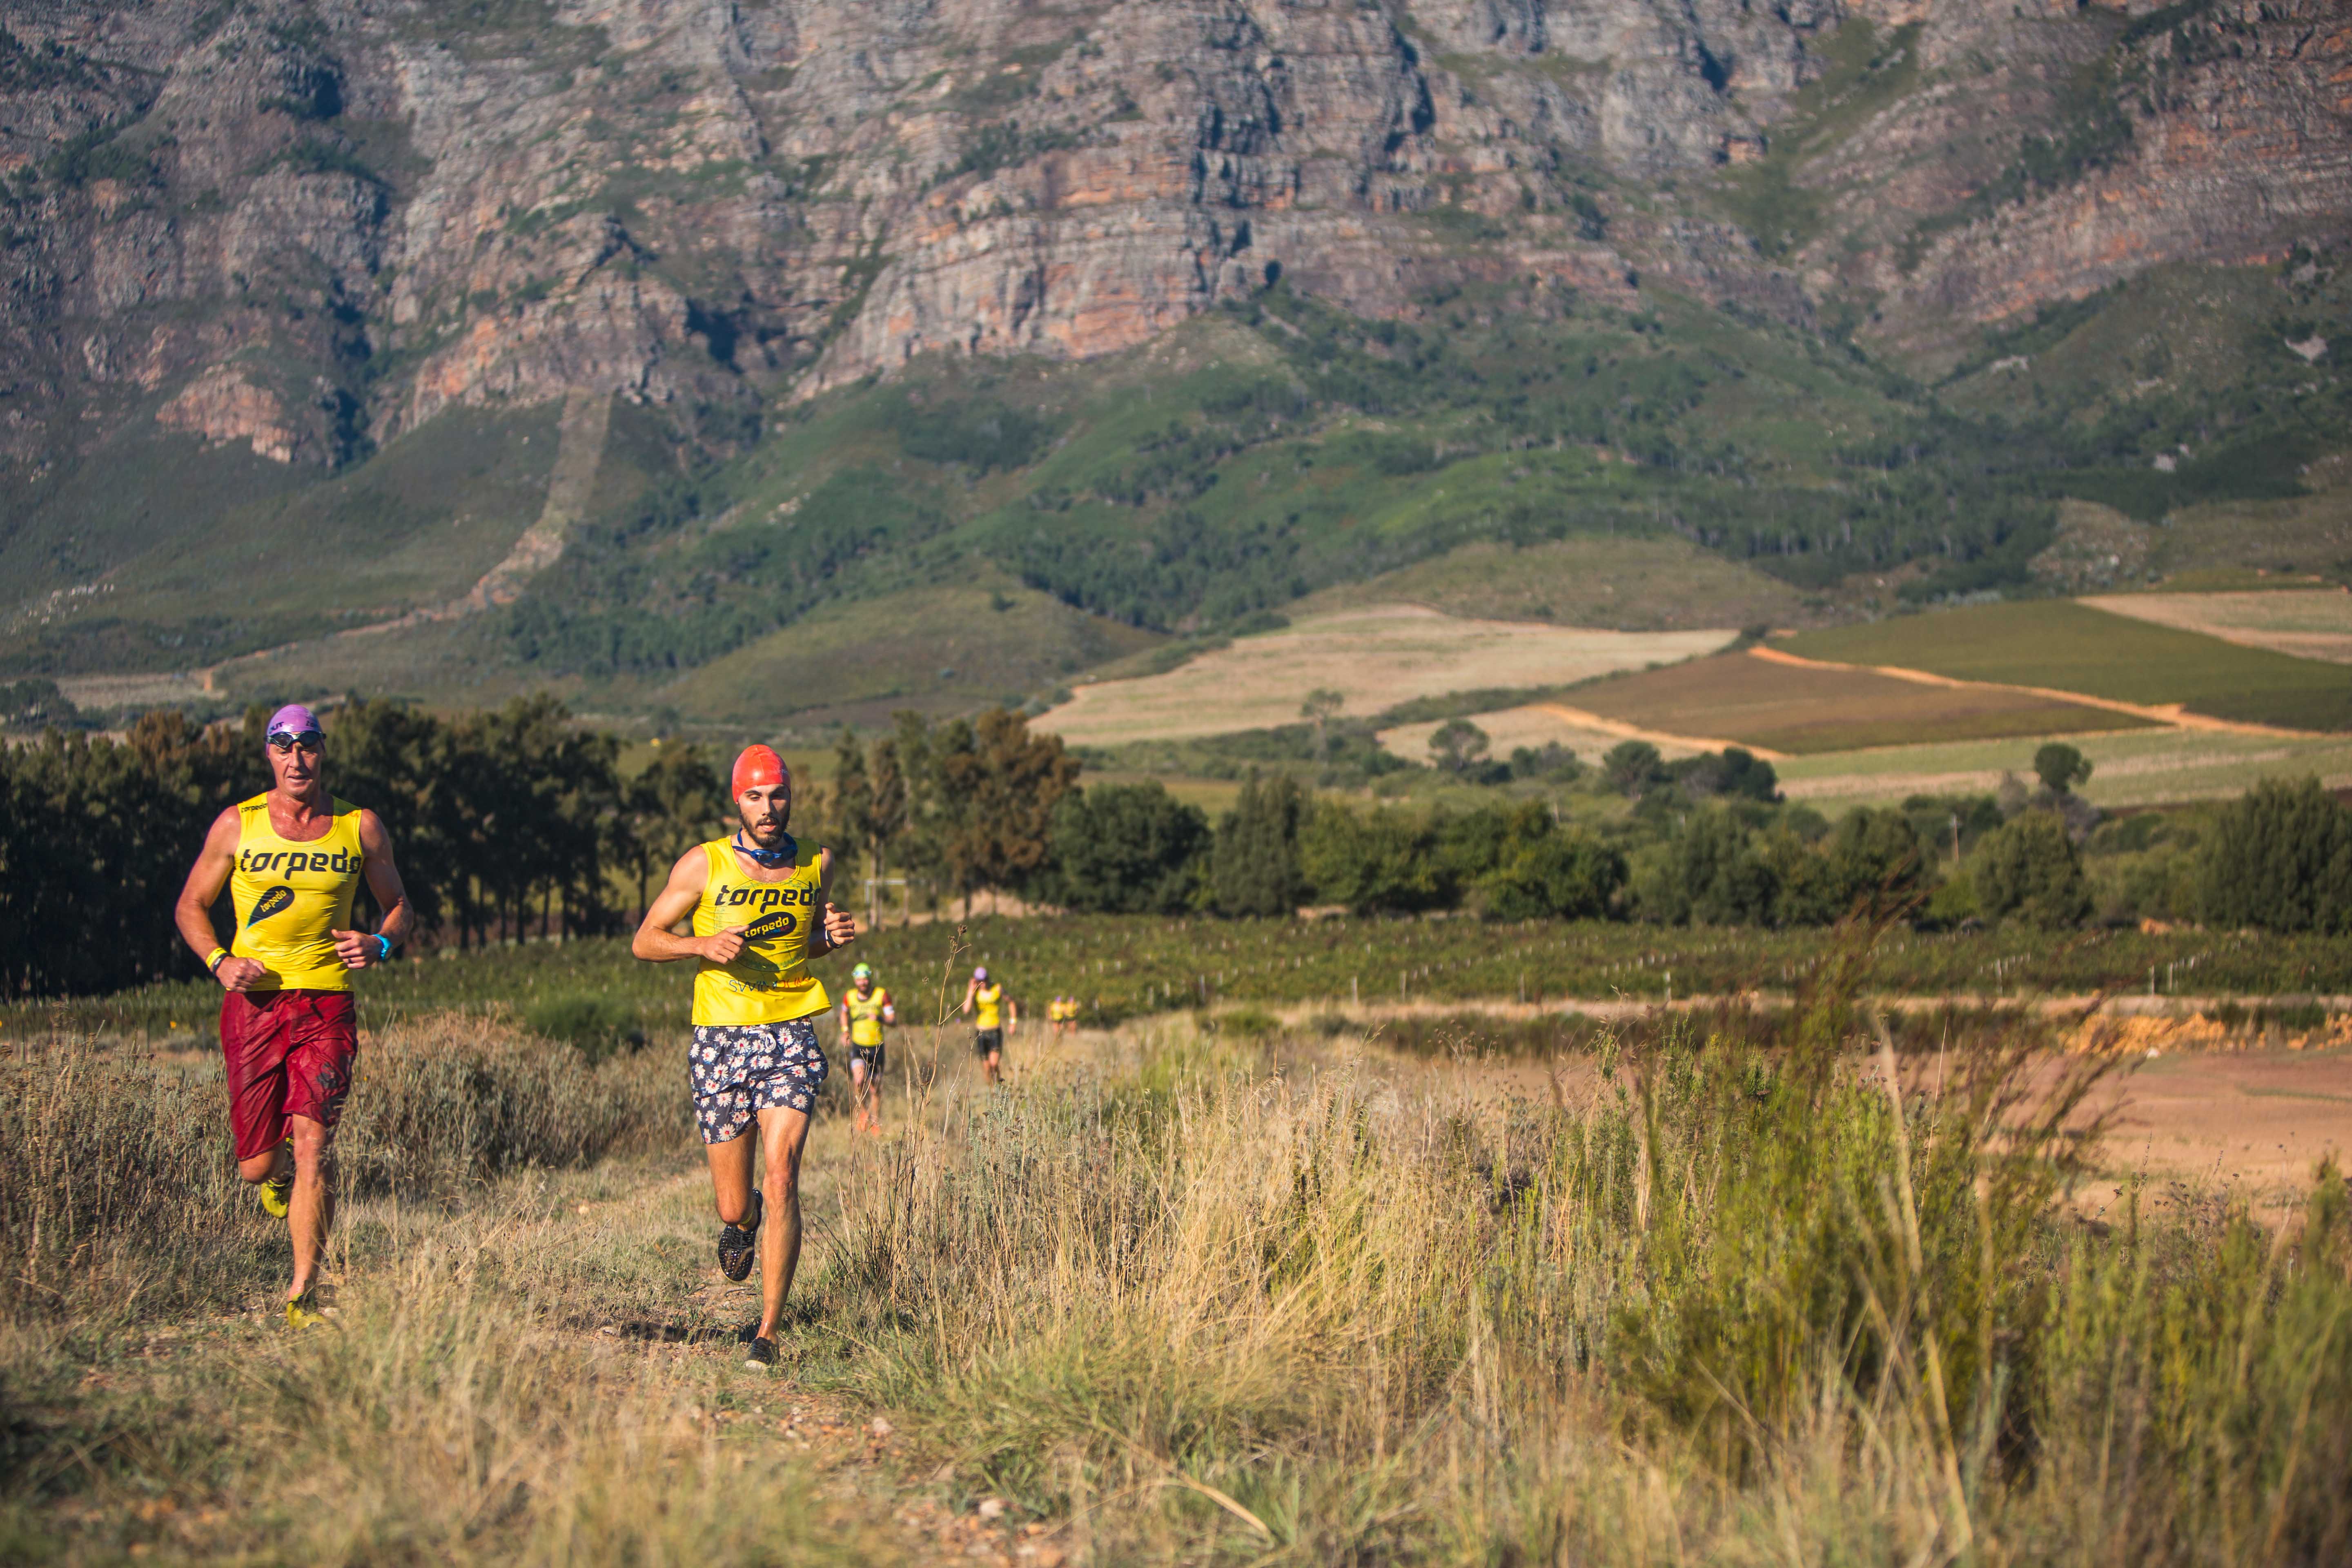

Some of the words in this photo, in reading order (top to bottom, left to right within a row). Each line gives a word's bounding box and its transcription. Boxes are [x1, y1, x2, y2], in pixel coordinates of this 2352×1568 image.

[241, 803, 268, 813] torpedo
[241, 846, 361, 880] torpedo
[260, 890, 287, 912] torpedo
[745, 916, 789, 938] torpedo
